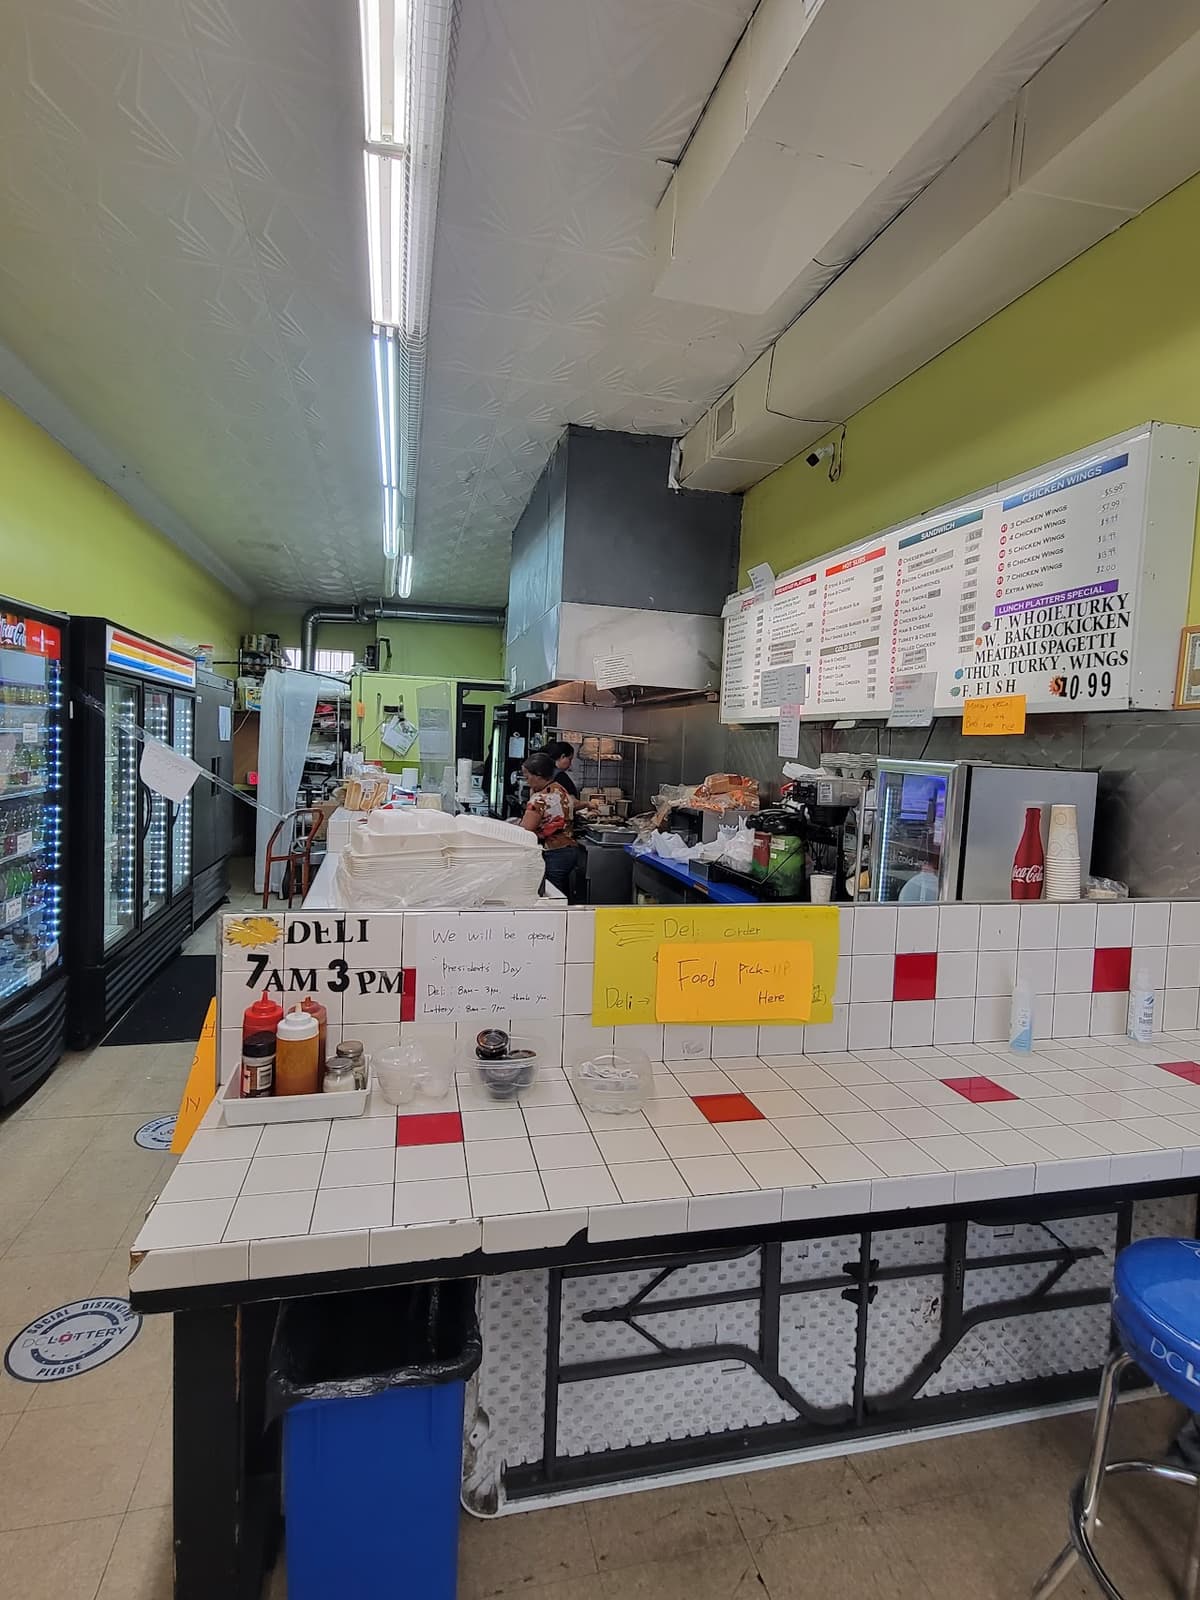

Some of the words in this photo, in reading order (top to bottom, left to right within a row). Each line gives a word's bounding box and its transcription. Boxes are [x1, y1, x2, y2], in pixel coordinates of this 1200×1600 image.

[1022, 480, 1065, 503] CHICKEN
[1067, 465, 1102, 486] WINGS
[1015, 514, 1044, 527] CHICKEN
[1045, 504, 1068, 518] WINGS
[921, 522, 955, 540] SANDWICH
[1014, 526, 1043, 540] CHICKEN
[1044, 518, 1066, 530] WINGS
[1013, 540, 1041, 553] CHICKEN
[1042, 533, 1065, 544] WINGS
[1012, 554, 1040, 567] CHICKEN
[1041, 548, 1064, 559] WINGS
[1011, 568, 1039, 580] CHICKEN
[1040, 562, 1063, 573] WINGS
[1005, 585, 1024, 595] EXTRA
[1025, 581, 1044, 591] WING
[999, 601, 1024, 614] LUNCH
[1024, 592, 1066, 609] PLATTERS
[1067, 585, 1104, 600] SPECIAL
[1070, 650, 1129, 671] WINGS
[977, 679, 1016, 696] FISH
[284, 918, 370, 945] DELI
[432, 928, 456, 943] We
[468, 928, 492, 941] will
[503, 927, 517, 940] be
[677, 958, 717, 991] Food
[605, 987, 633, 1010] Deli
[759, 991, 785, 1004] Here
[27, 1309, 70, 1335] SOCIAL
[82, 1301, 135, 1322] DISTANCING
[48, 1326, 128, 1344] LOTTERY
[36, 1362, 82, 1377] PLEASE
